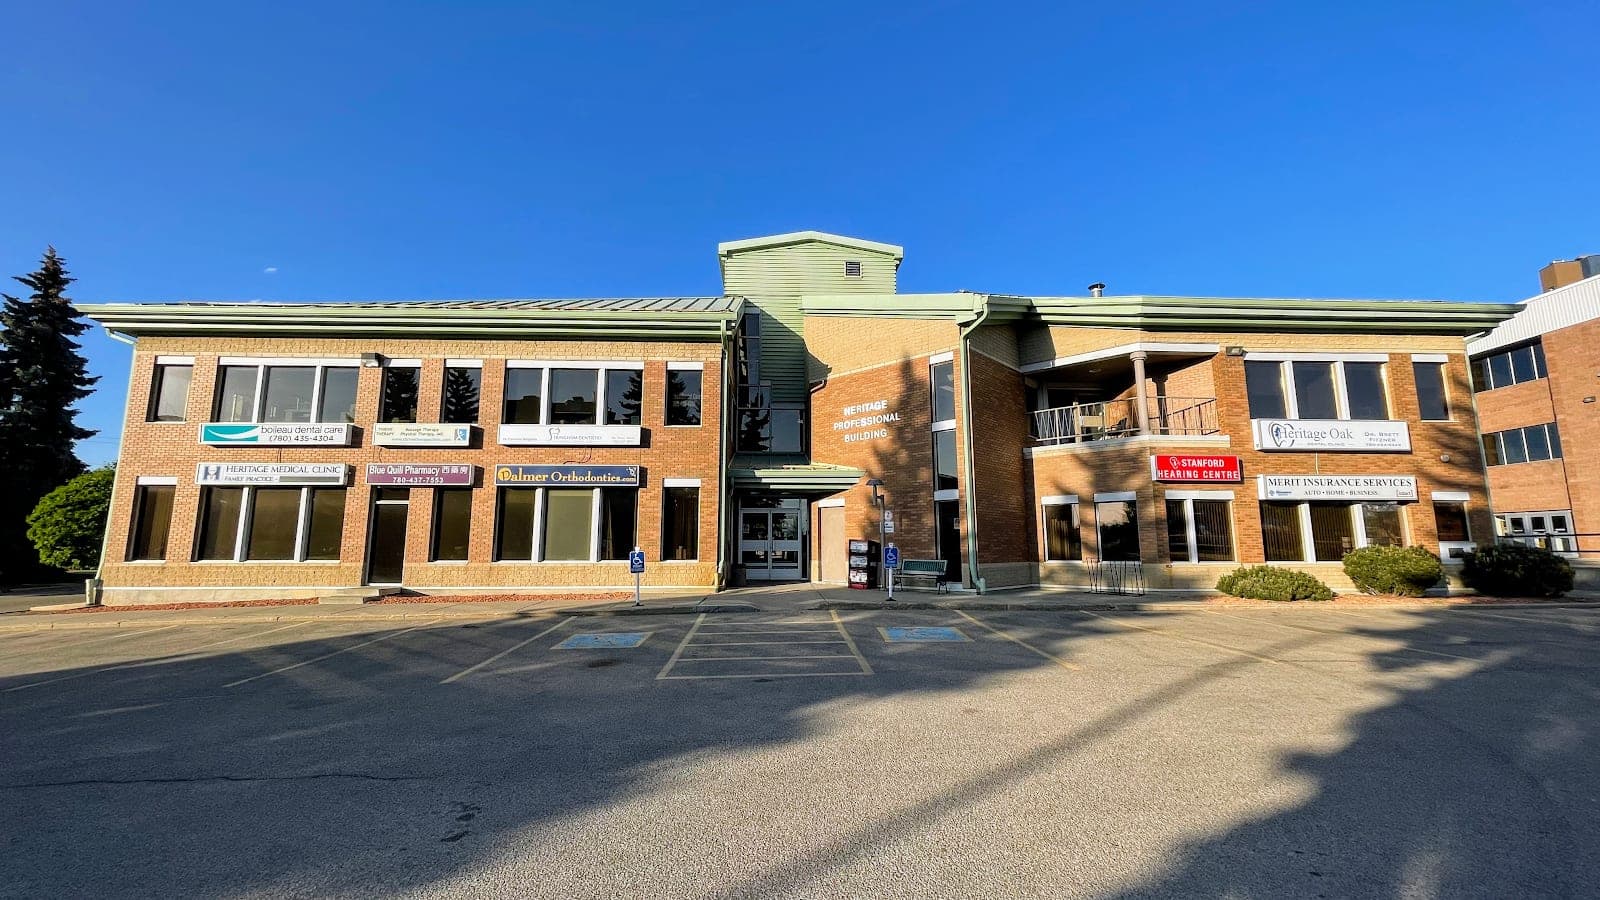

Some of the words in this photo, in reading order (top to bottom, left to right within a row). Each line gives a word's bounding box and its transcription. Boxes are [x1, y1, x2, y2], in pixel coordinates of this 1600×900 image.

[843, 400, 888, 416] HERITAGE
[833, 412, 901, 430] PROFESSIONAL
[261, 425, 293, 434] boileau
[295, 425, 322, 434] dental
[1280, 427, 1327, 442] Heritage
[1329, 427, 1353, 439] Oak
[844, 429, 888, 443] BUILDING
[226, 465, 269, 473] HERITAGE
[271, 465, 309, 473] MEDICAL
[1181, 459, 1225, 468] STANFORD
[369, 465, 385, 475] Blue
[387, 465, 403, 475] Quill
[405, 465, 440, 476] Pharmacy
[498, 467, 549, 482] Palmer
[1158, 470, 1199, 479] HEARING
[1202, 470, 1239, 479] CENTRE
[1268, 478, 1300, 486] MERIT
[1303, 478, 1361, 486] INSURANCE
[1363, 478, 1412, 487] SERVICES
